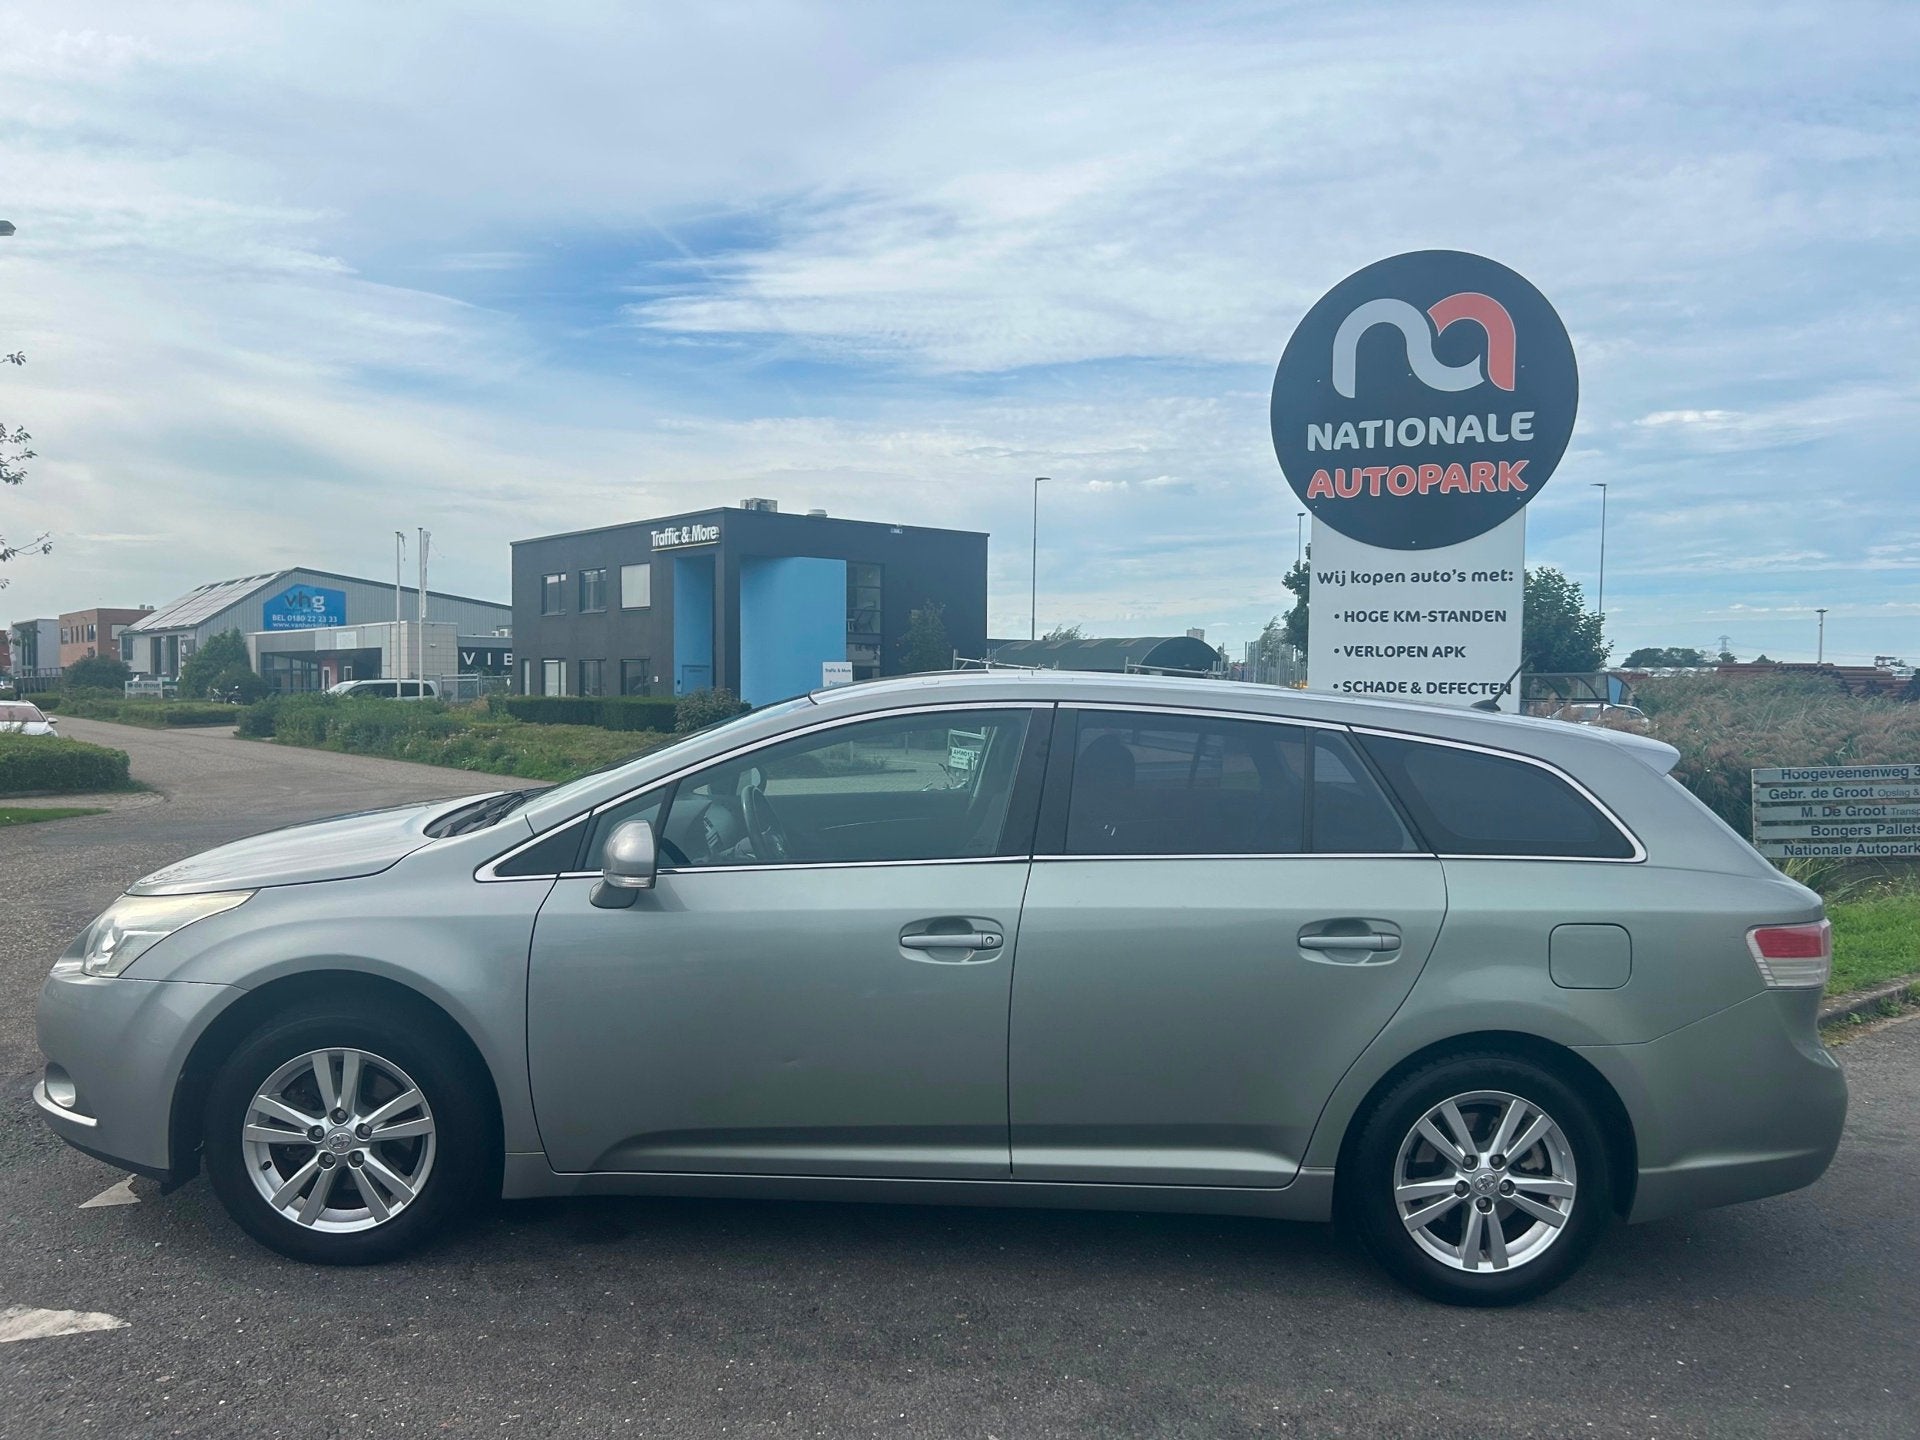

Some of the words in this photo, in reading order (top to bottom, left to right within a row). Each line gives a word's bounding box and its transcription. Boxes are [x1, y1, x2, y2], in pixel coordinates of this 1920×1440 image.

[1307, 411, 1535, 451] NATIONALE
[1306, 460, 1530, 499] AUTOPARK
[651, 528, 681, 546] Traffic
[681, 527, 691, 543] &
[692, 525, 719, 541] More
[1317, 571, 1346, 587] Wij
[1351, 571, 1405, 585] kopen
[1410, 569, 1466, 583] auto's
[1471, 569, 1513, 582] met:
[285, 591, 325, 612] vhg
[1344, 610, 1389, 622] HOGE
[1394, 610, 1506, 622] KM-STANDEN
[1344, 646, 1427, 658] VERLOPEN
[1432, 646, 1466, 658] APK
[1343, 681, 1407, 693] SCHADE
[1410, 682, 1421, 694] &
[1426, 682, 1511, 694] DEFECTEN
[1782, 767, 1909, 781] Hoogeveenenweg
[1769, 789, 1806, 799] Gebr.
[1811, 788, 1829, 798] de
[1833, 788, 1873, 798] Groot
[1878, 789, 1910, 797] Opslag
[1802, 807, 1816, 817] M.
[1823, 807, 1841, 817] De
[1845, 806, 1887, 816] Groot
[1811, 825, 1871, 838] Bongers
[1784, 845, 1852, 855] Nationale
[1856, 843, 1920, 855] Autopark
